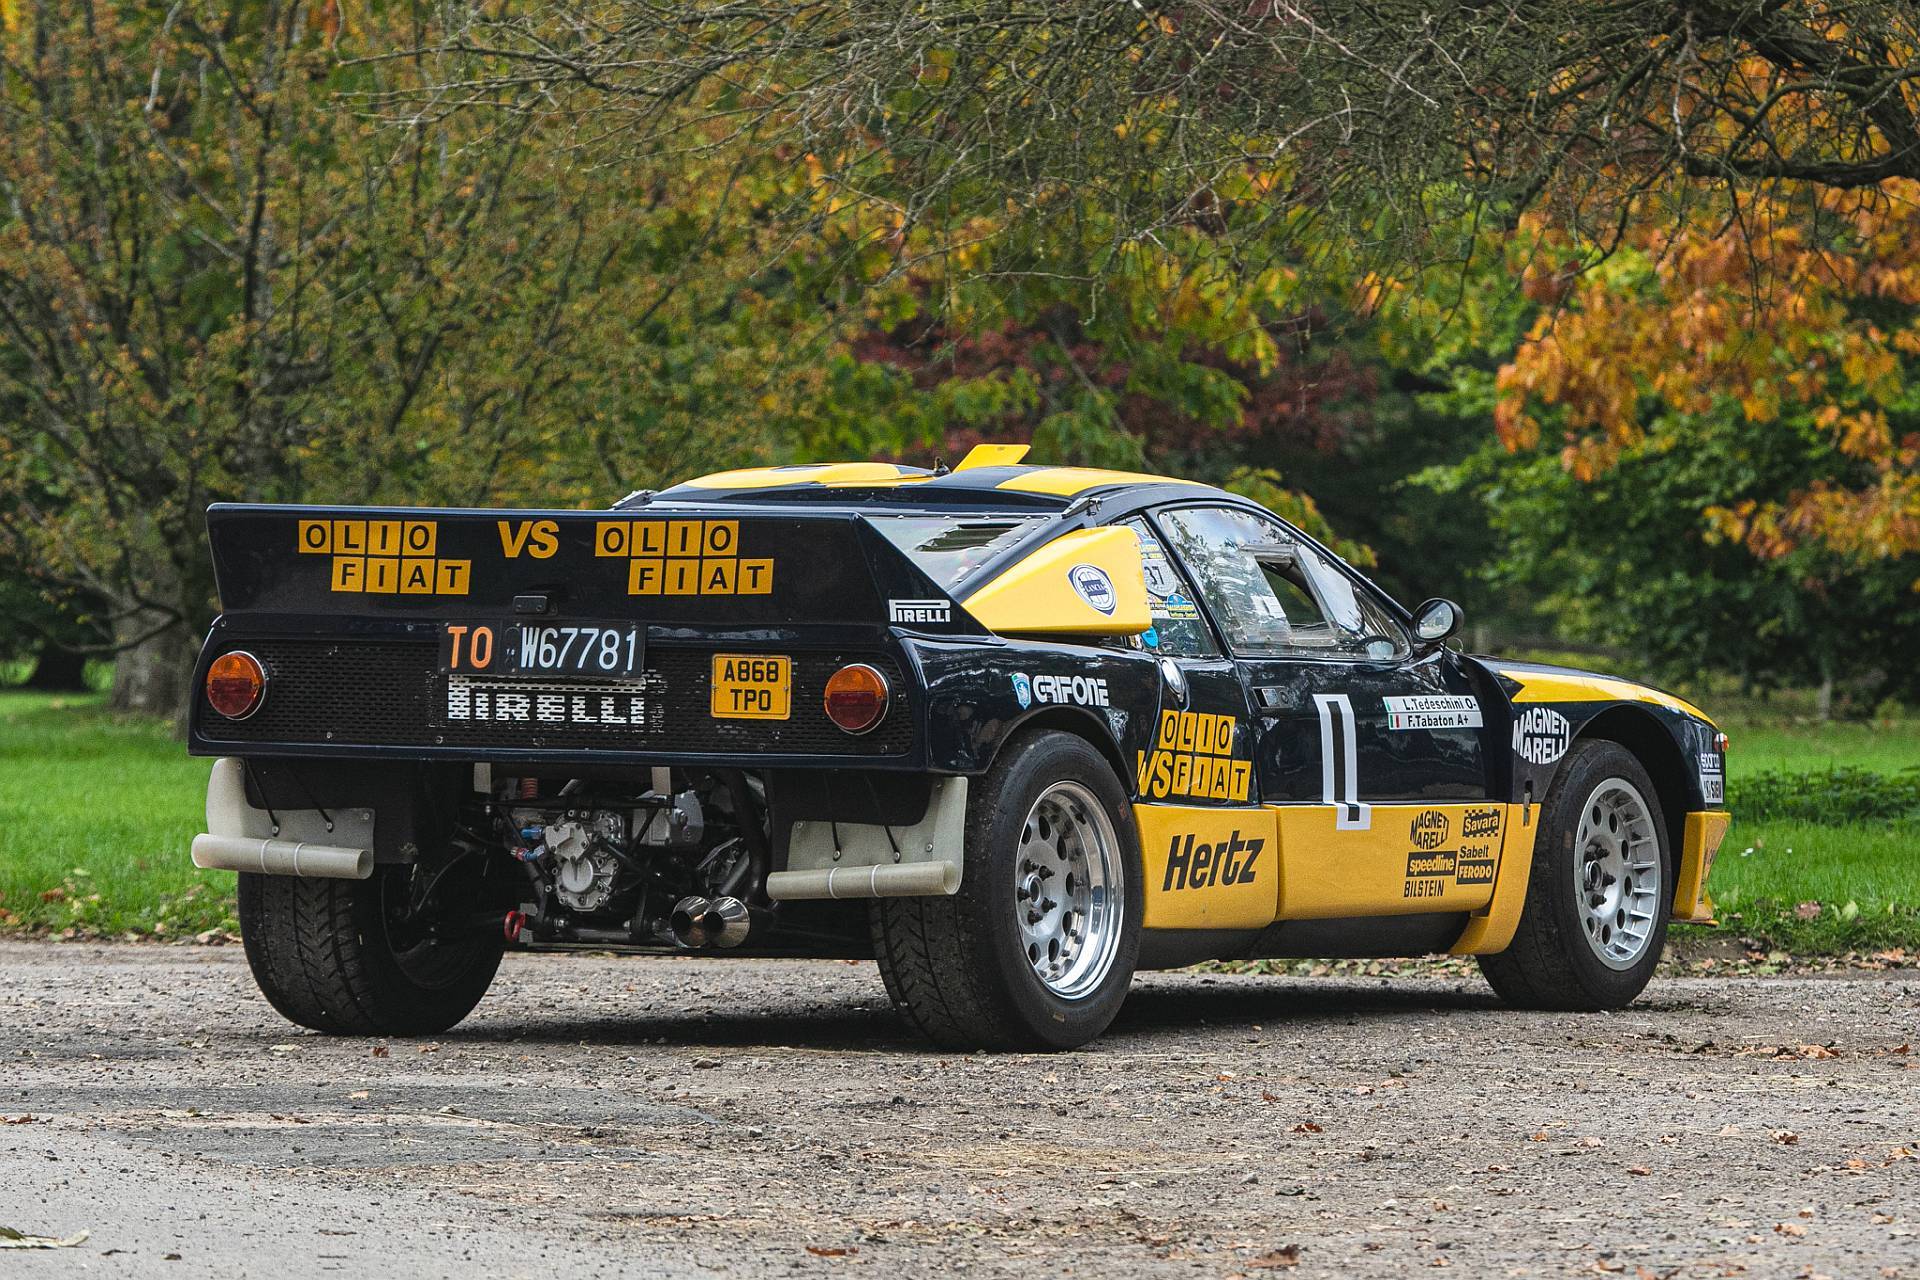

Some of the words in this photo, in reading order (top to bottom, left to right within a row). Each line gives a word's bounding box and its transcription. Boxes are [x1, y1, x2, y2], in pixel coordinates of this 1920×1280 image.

[306, 524, 430, 550] OLIO
[498, 520, 559, 559] VS
[602, 525, 731, 553] OLIO
[341, 562, 463, 588] FIAT
[638, 565, 765, 590] FIAT
[888, 599, 951, 622] PIRELLI
[448, 626, 493, 669] TO
[520, 627, 637, 671] W67781
[723, 660, 779, 682] A868
[730, 689, 771, 711] TPO
[1032, 675, 1110, 706] GRIFONE
[1164, 714, 1231, 750] OLIO
[1408, 714, 1454, 727] F.Tabaton
[1457, 713, 1469, 726] A+
[1137, 750, 1174, 798] VS
[1177, 763, 1247, 796] FIAT
[1464, 816, 1499, 832] Savara
[1162, 830, 1265, 891] Hertz
[1460, 845, 1489, 858] Sabelt
[1409, 855, 1455, 875] speedline
[1458, 865, 1493, 879] FERODO
[1404, 880, 1445, 897] BILSTEIN
